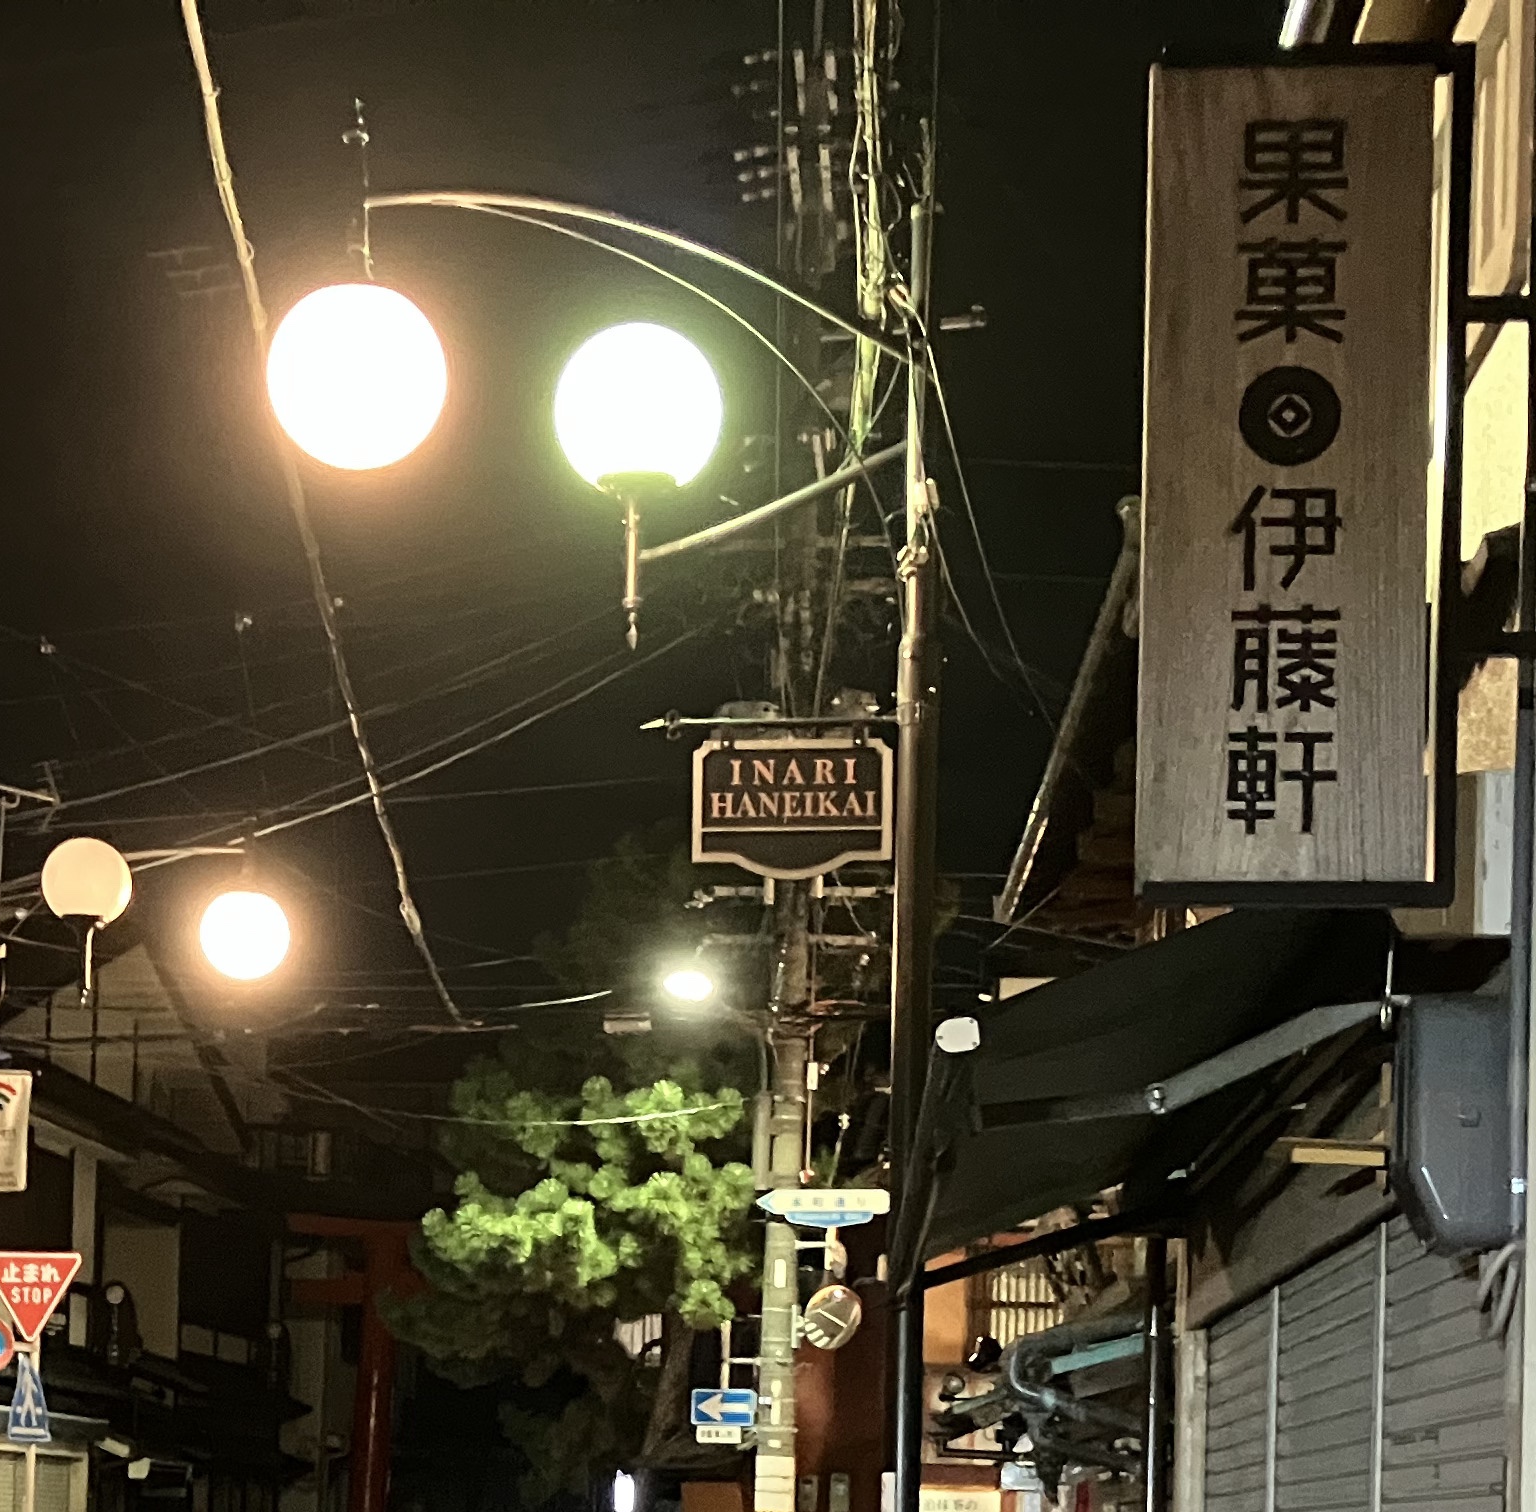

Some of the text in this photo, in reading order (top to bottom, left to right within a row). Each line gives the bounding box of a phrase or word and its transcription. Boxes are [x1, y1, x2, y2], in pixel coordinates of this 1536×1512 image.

[1227, 485, 1343, 835] 伊藤軒
[730, 758, 857, 785] INARI
[710, 790, 877, 818] HANEIKAI
[1, 1261, 61, 1283] 止まれ
[11, 1286, 52, 1304] STOP
